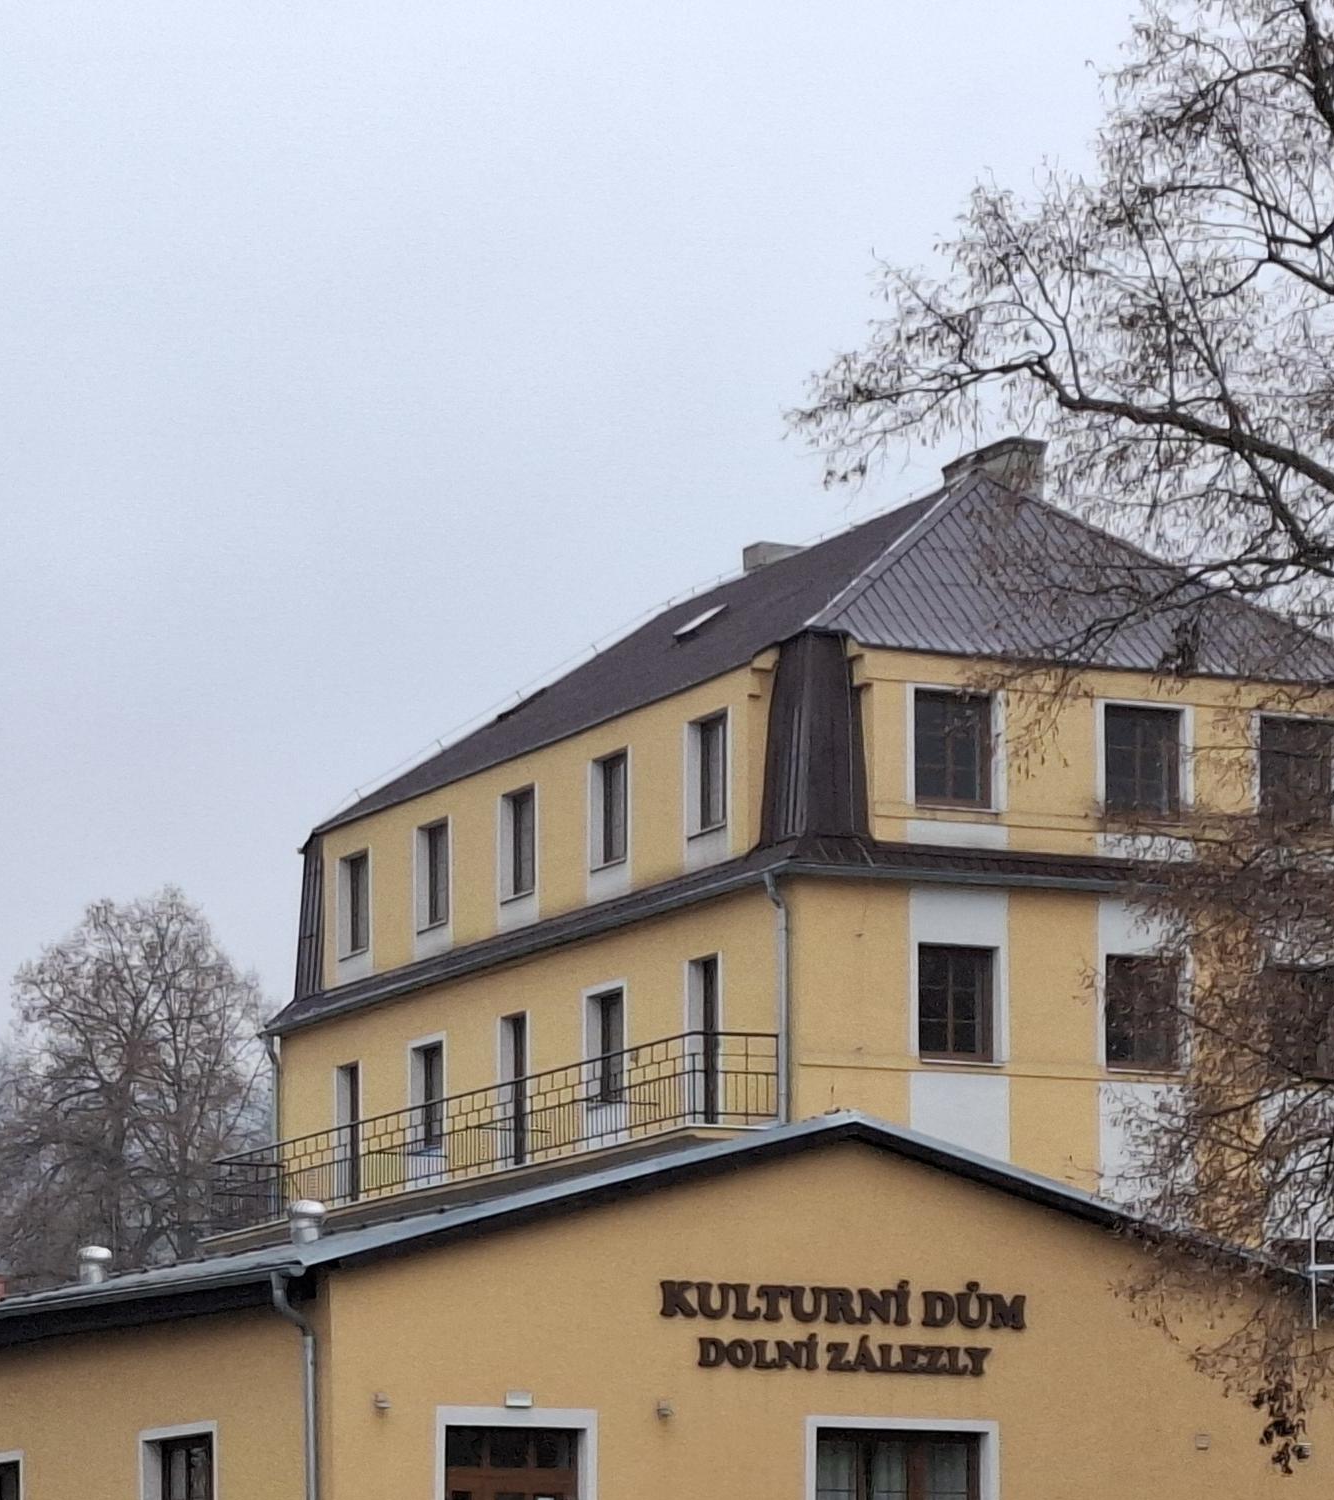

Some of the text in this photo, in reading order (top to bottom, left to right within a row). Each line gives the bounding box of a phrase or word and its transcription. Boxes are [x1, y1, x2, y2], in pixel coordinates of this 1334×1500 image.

[659, 1279, 1027, 1331] KULTURNÍ DŮM
[698, 1333, 992, 1377] DOLNÍ ZÁLEZLY
